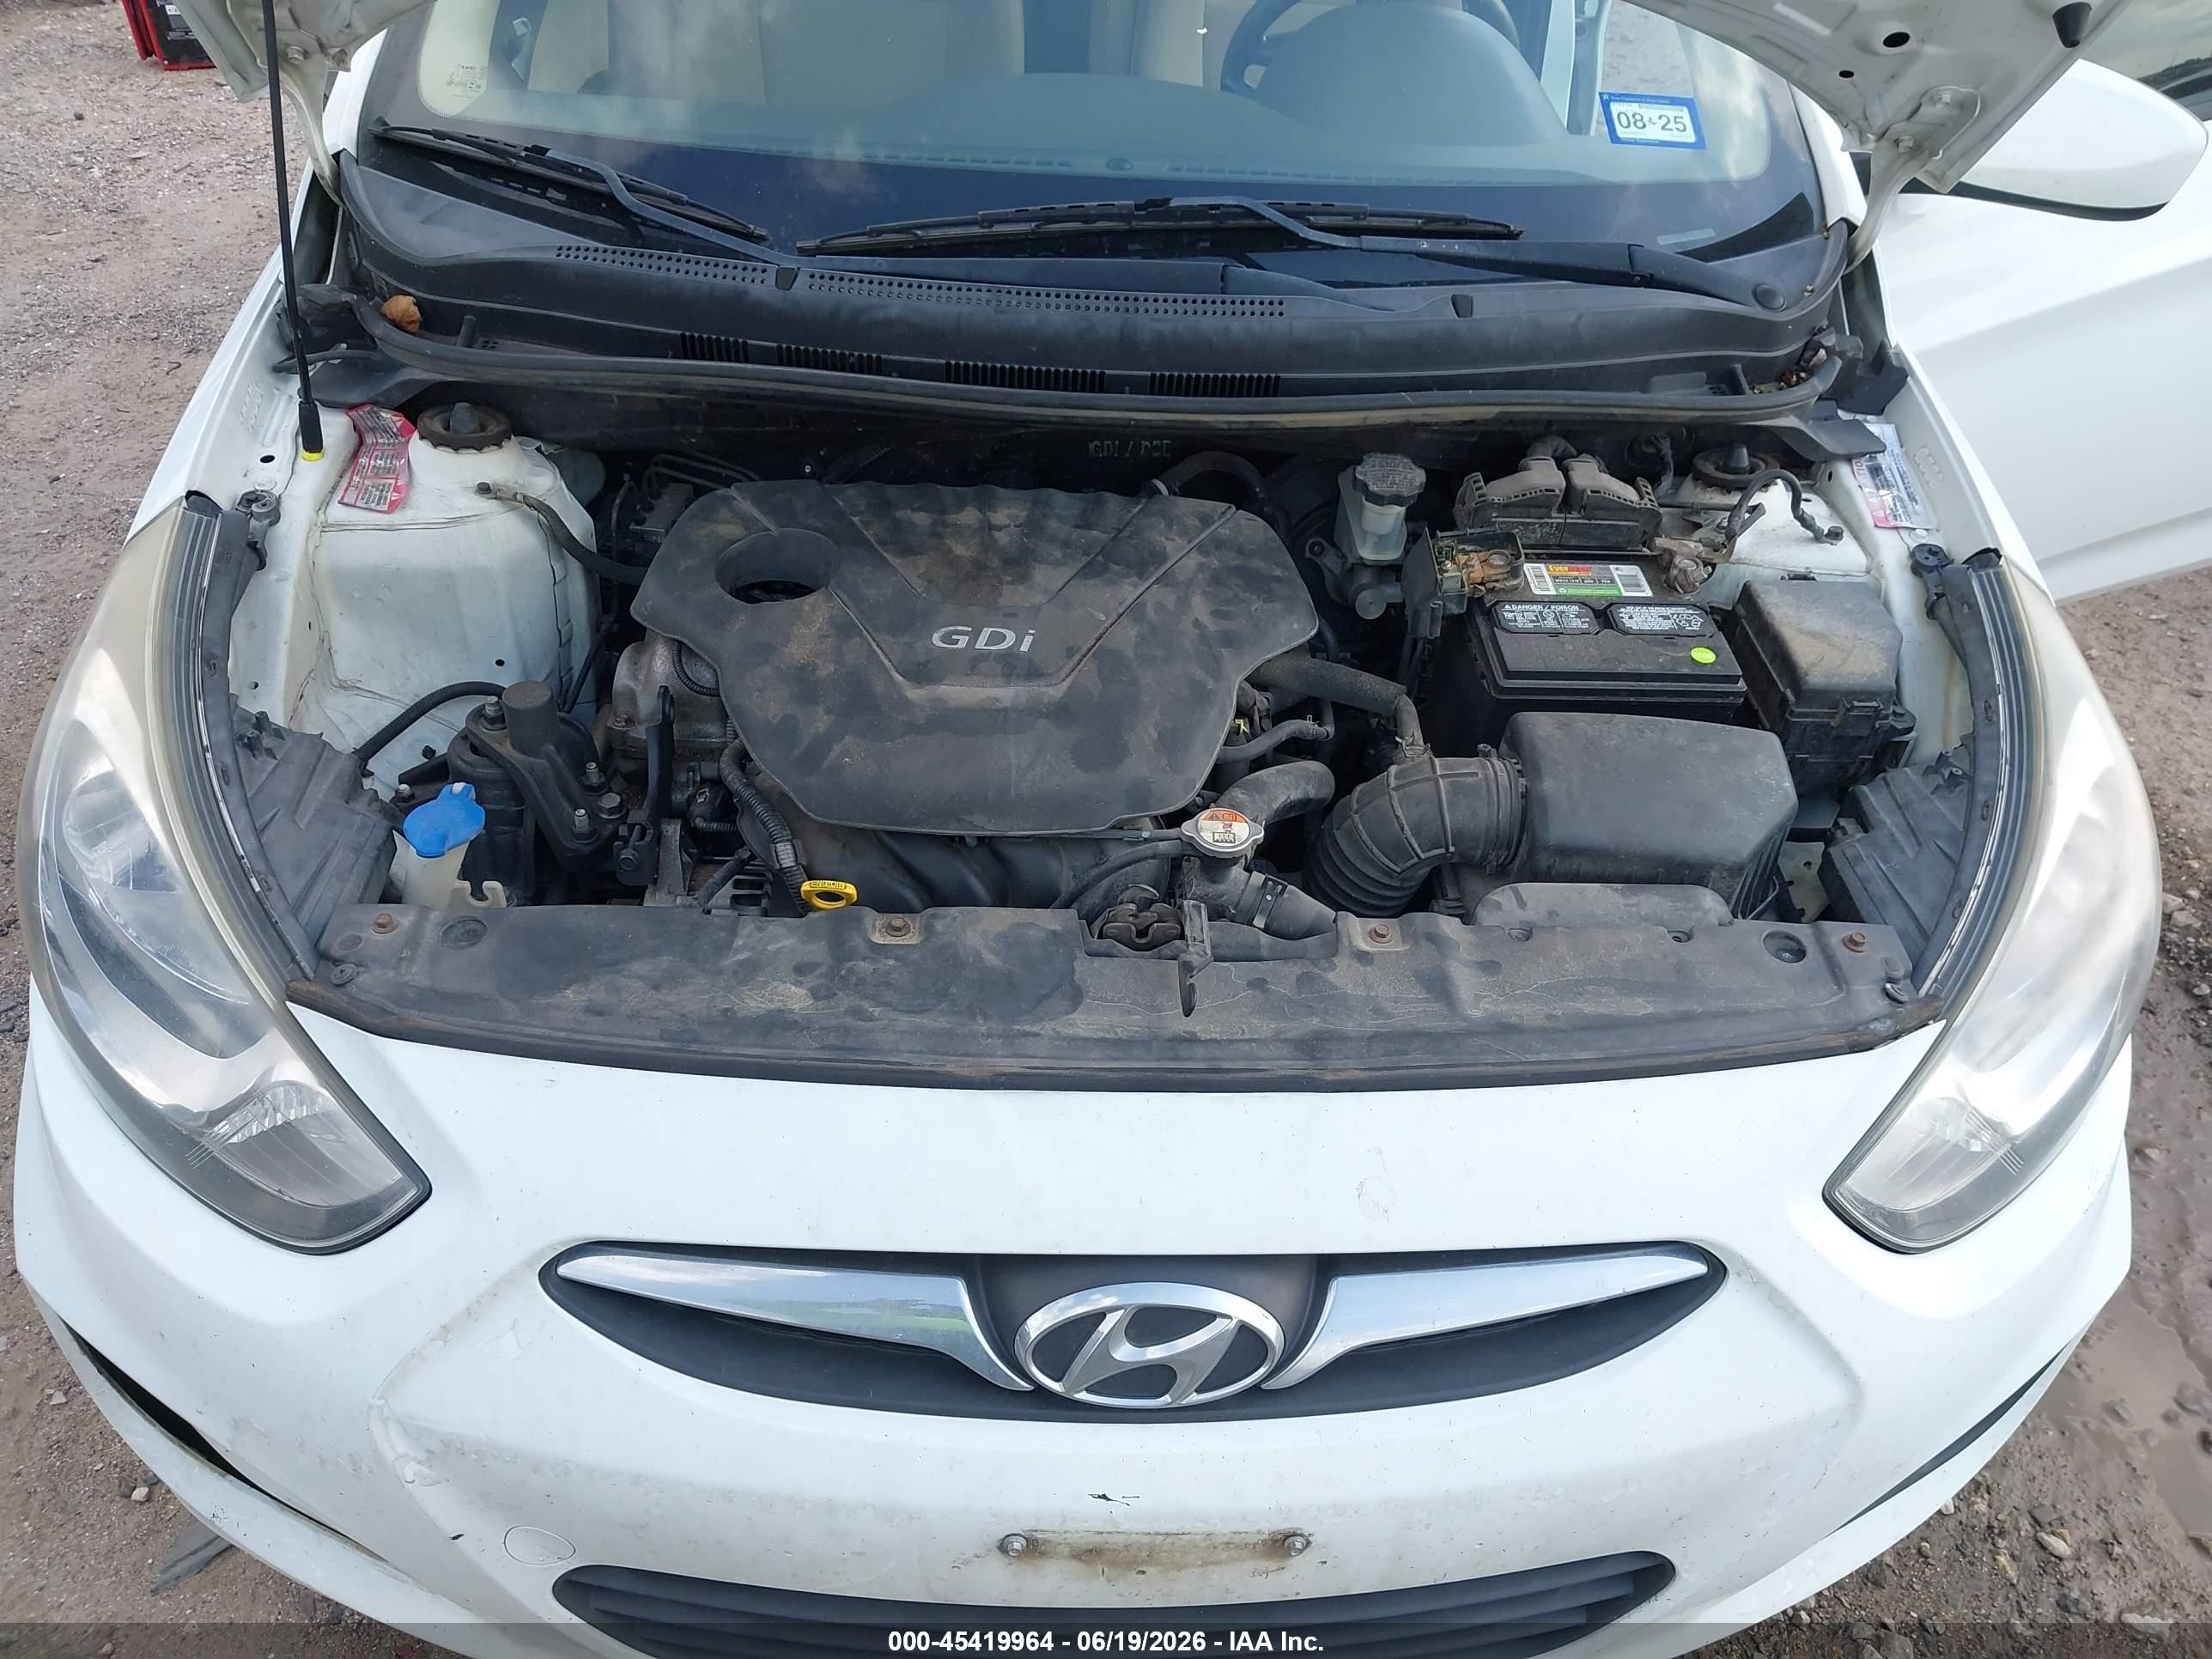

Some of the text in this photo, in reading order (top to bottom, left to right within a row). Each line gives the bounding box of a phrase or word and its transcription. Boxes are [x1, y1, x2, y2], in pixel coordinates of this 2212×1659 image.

[1616, 111, 1687, 133] 08 25
[930, 625, 1036, 653] GDi
